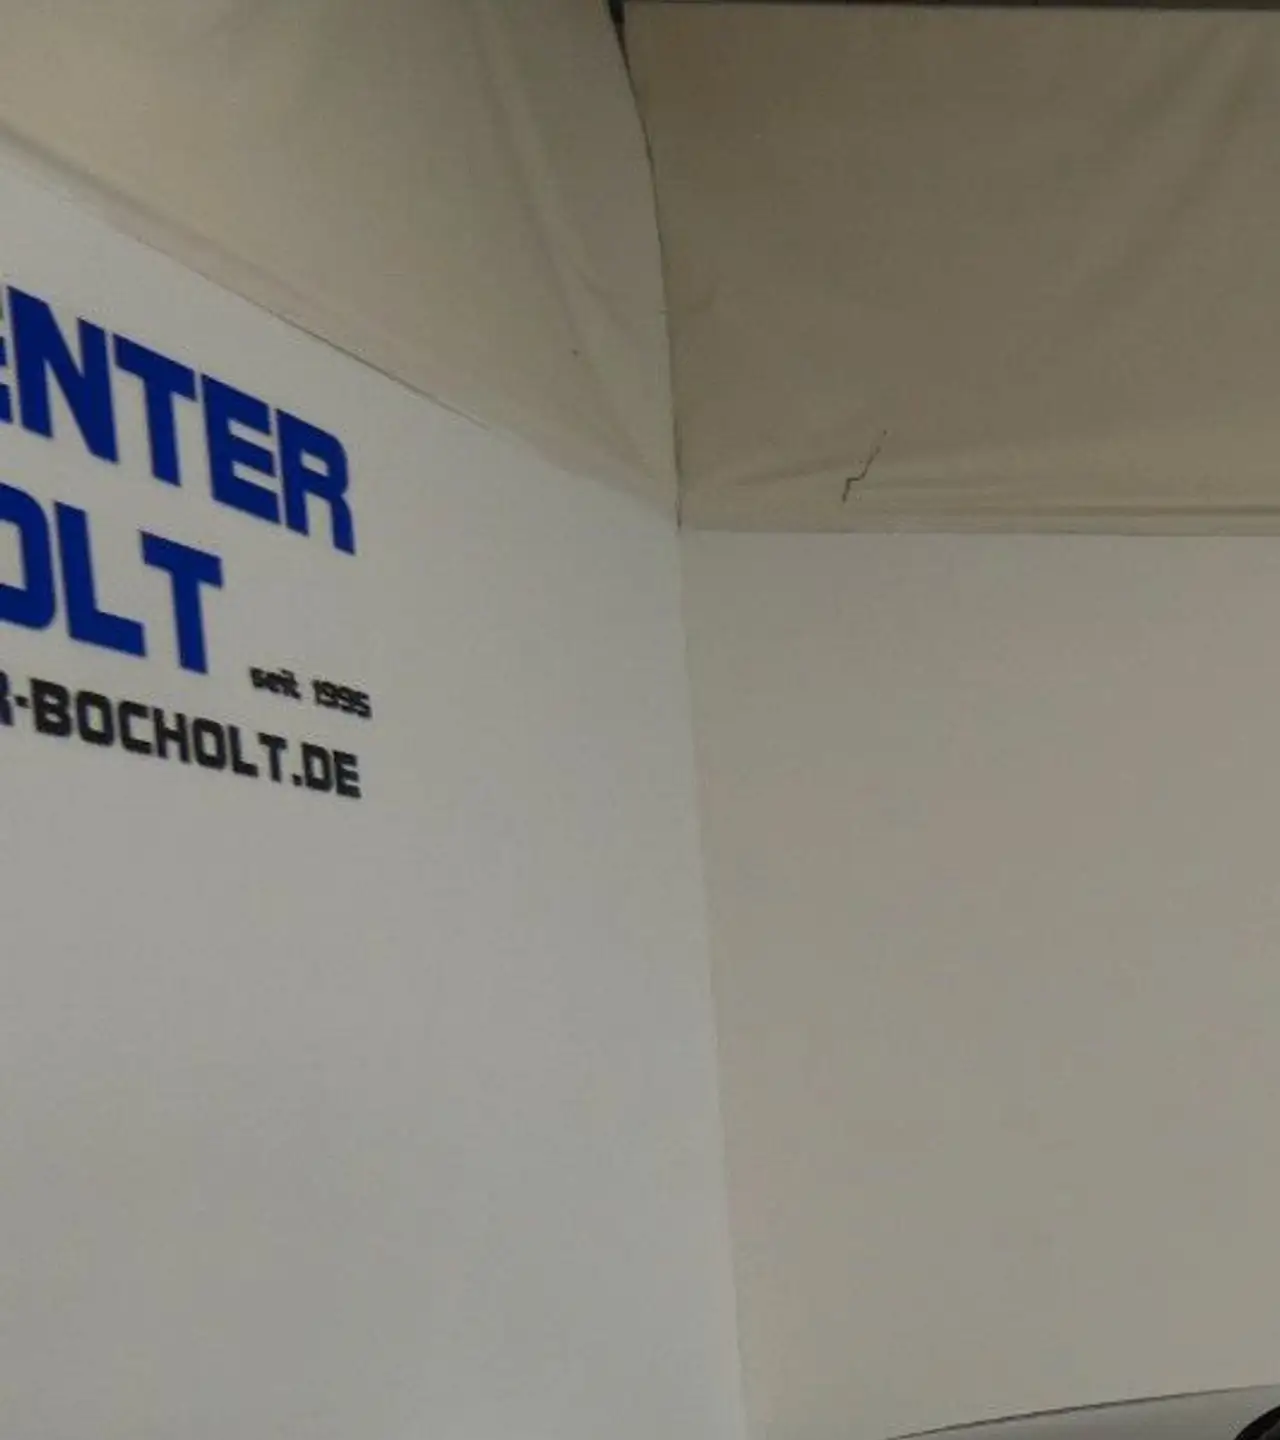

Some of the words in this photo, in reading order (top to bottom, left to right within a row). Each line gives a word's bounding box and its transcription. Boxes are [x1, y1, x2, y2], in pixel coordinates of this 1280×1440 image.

[0, 285, 356, 556] NTER
[0, 668, 362, 800] -BOCHOLT.DE
[249, 666, 303, 700] seit
[311, 678, 372, 719] 1995
